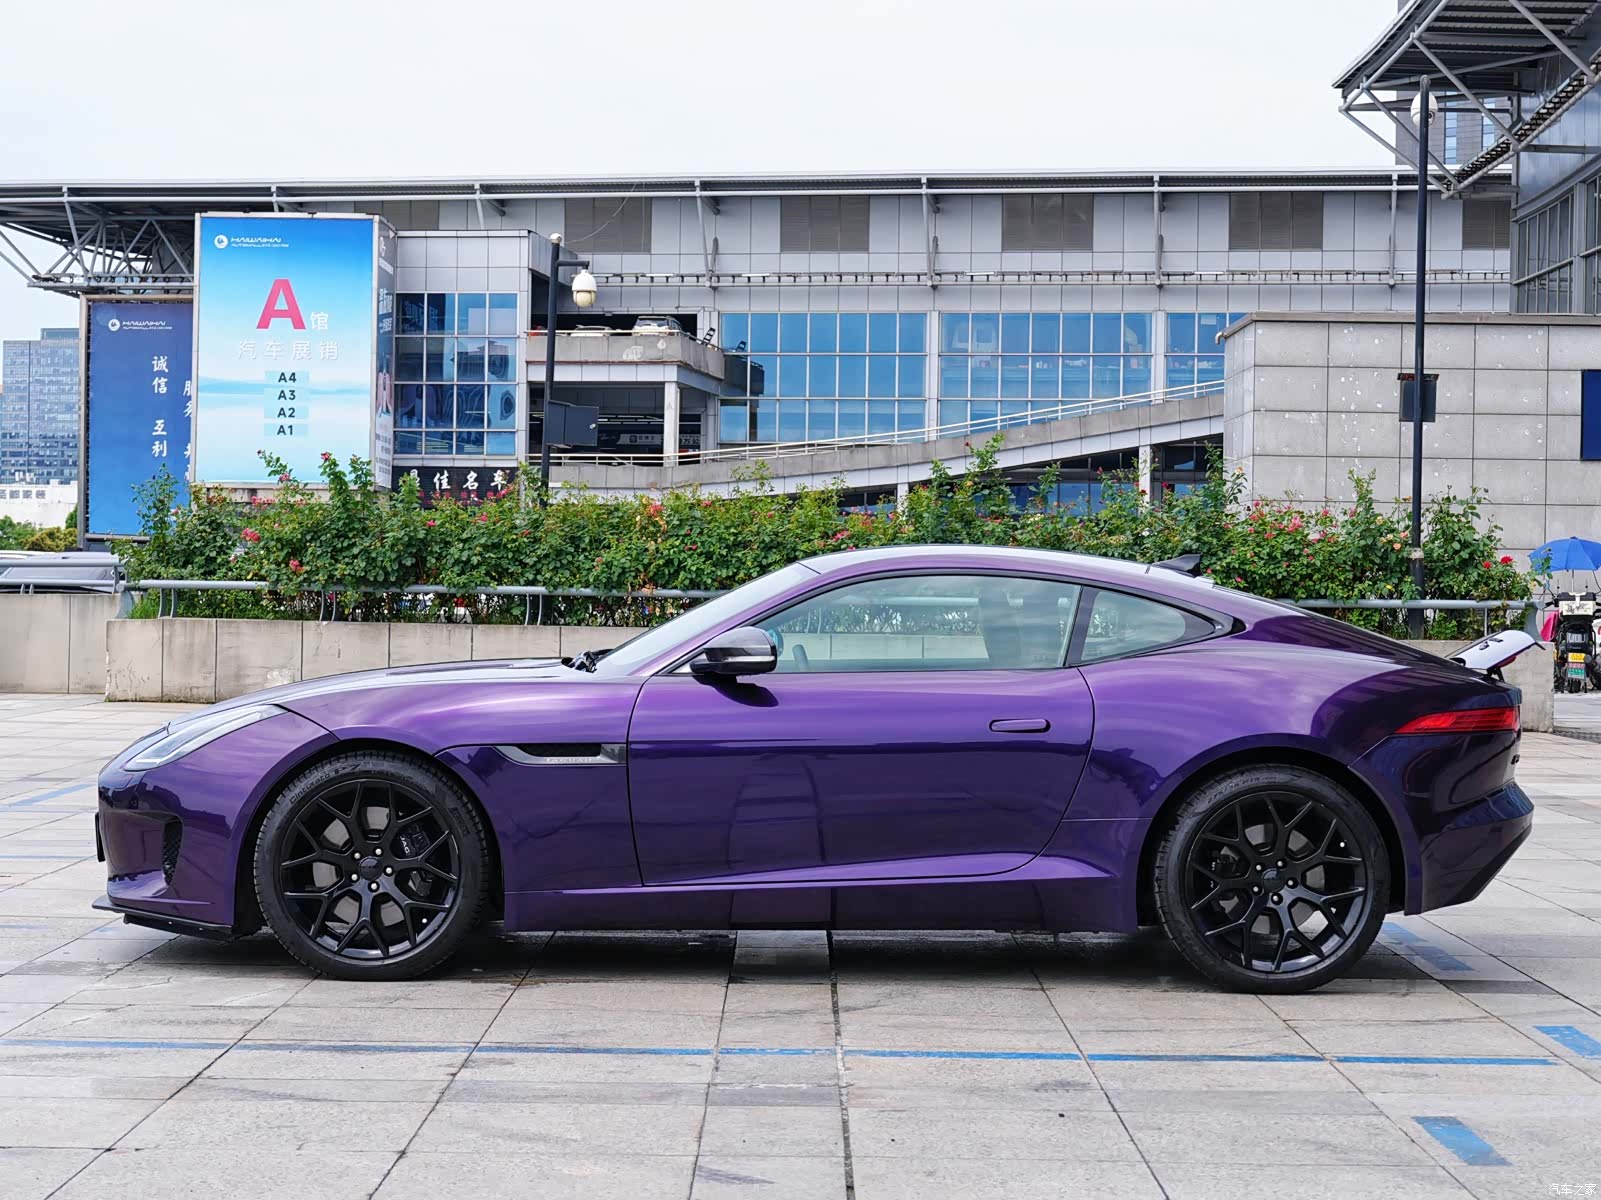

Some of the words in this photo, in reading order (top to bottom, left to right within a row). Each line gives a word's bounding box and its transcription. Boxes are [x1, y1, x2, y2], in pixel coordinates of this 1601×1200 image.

[236, 340, 340, 361] 汽车展销
[151, 355, 169, 395] 诚信
[278, 372, 297, 383] A4
[277, 389, 296, 401] A3
[277, 407, 296, 418] A2
[277, 424, 293, 436] A1
[151, 419, 168, 458] 互利
